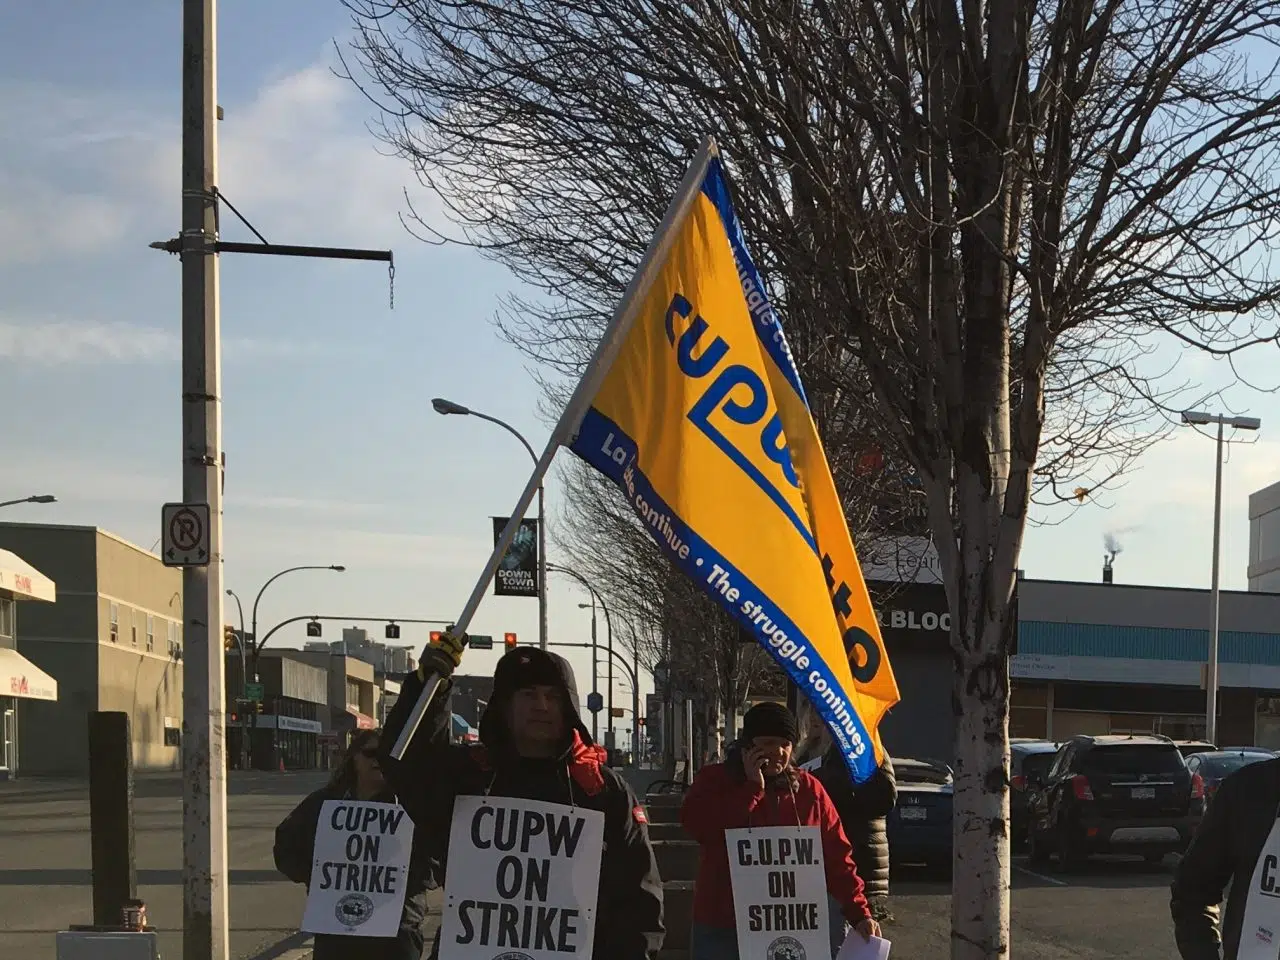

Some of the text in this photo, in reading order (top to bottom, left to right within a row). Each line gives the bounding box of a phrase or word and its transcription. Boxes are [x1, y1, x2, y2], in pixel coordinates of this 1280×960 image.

[600, 432, 627, 466] La
[635, 494, 691, 560] continue
[498, 569, 532, 579] DOWN
[502, 577, 534, 587] town
[891, 610, 952, 632] BLOC
[706, 564, 740, 603] The
[740, 600, 809, 670] struggle
[808, 670, 867, 756] continues
[331, 805, 404, 835] CUPW
[471, 805, 587, 858] CUPW
[345, 834, 379, 863] ON
[738, 839, 819, 868] C.U.P.W.
[320, 861, 398, 894] STRIKE
[496, 856, 550, 902] ON
[768, 871, 796, 898] ON
[456, 901, 579, 953] STRIKE
[749, 903, 819, 931] STRIKE
